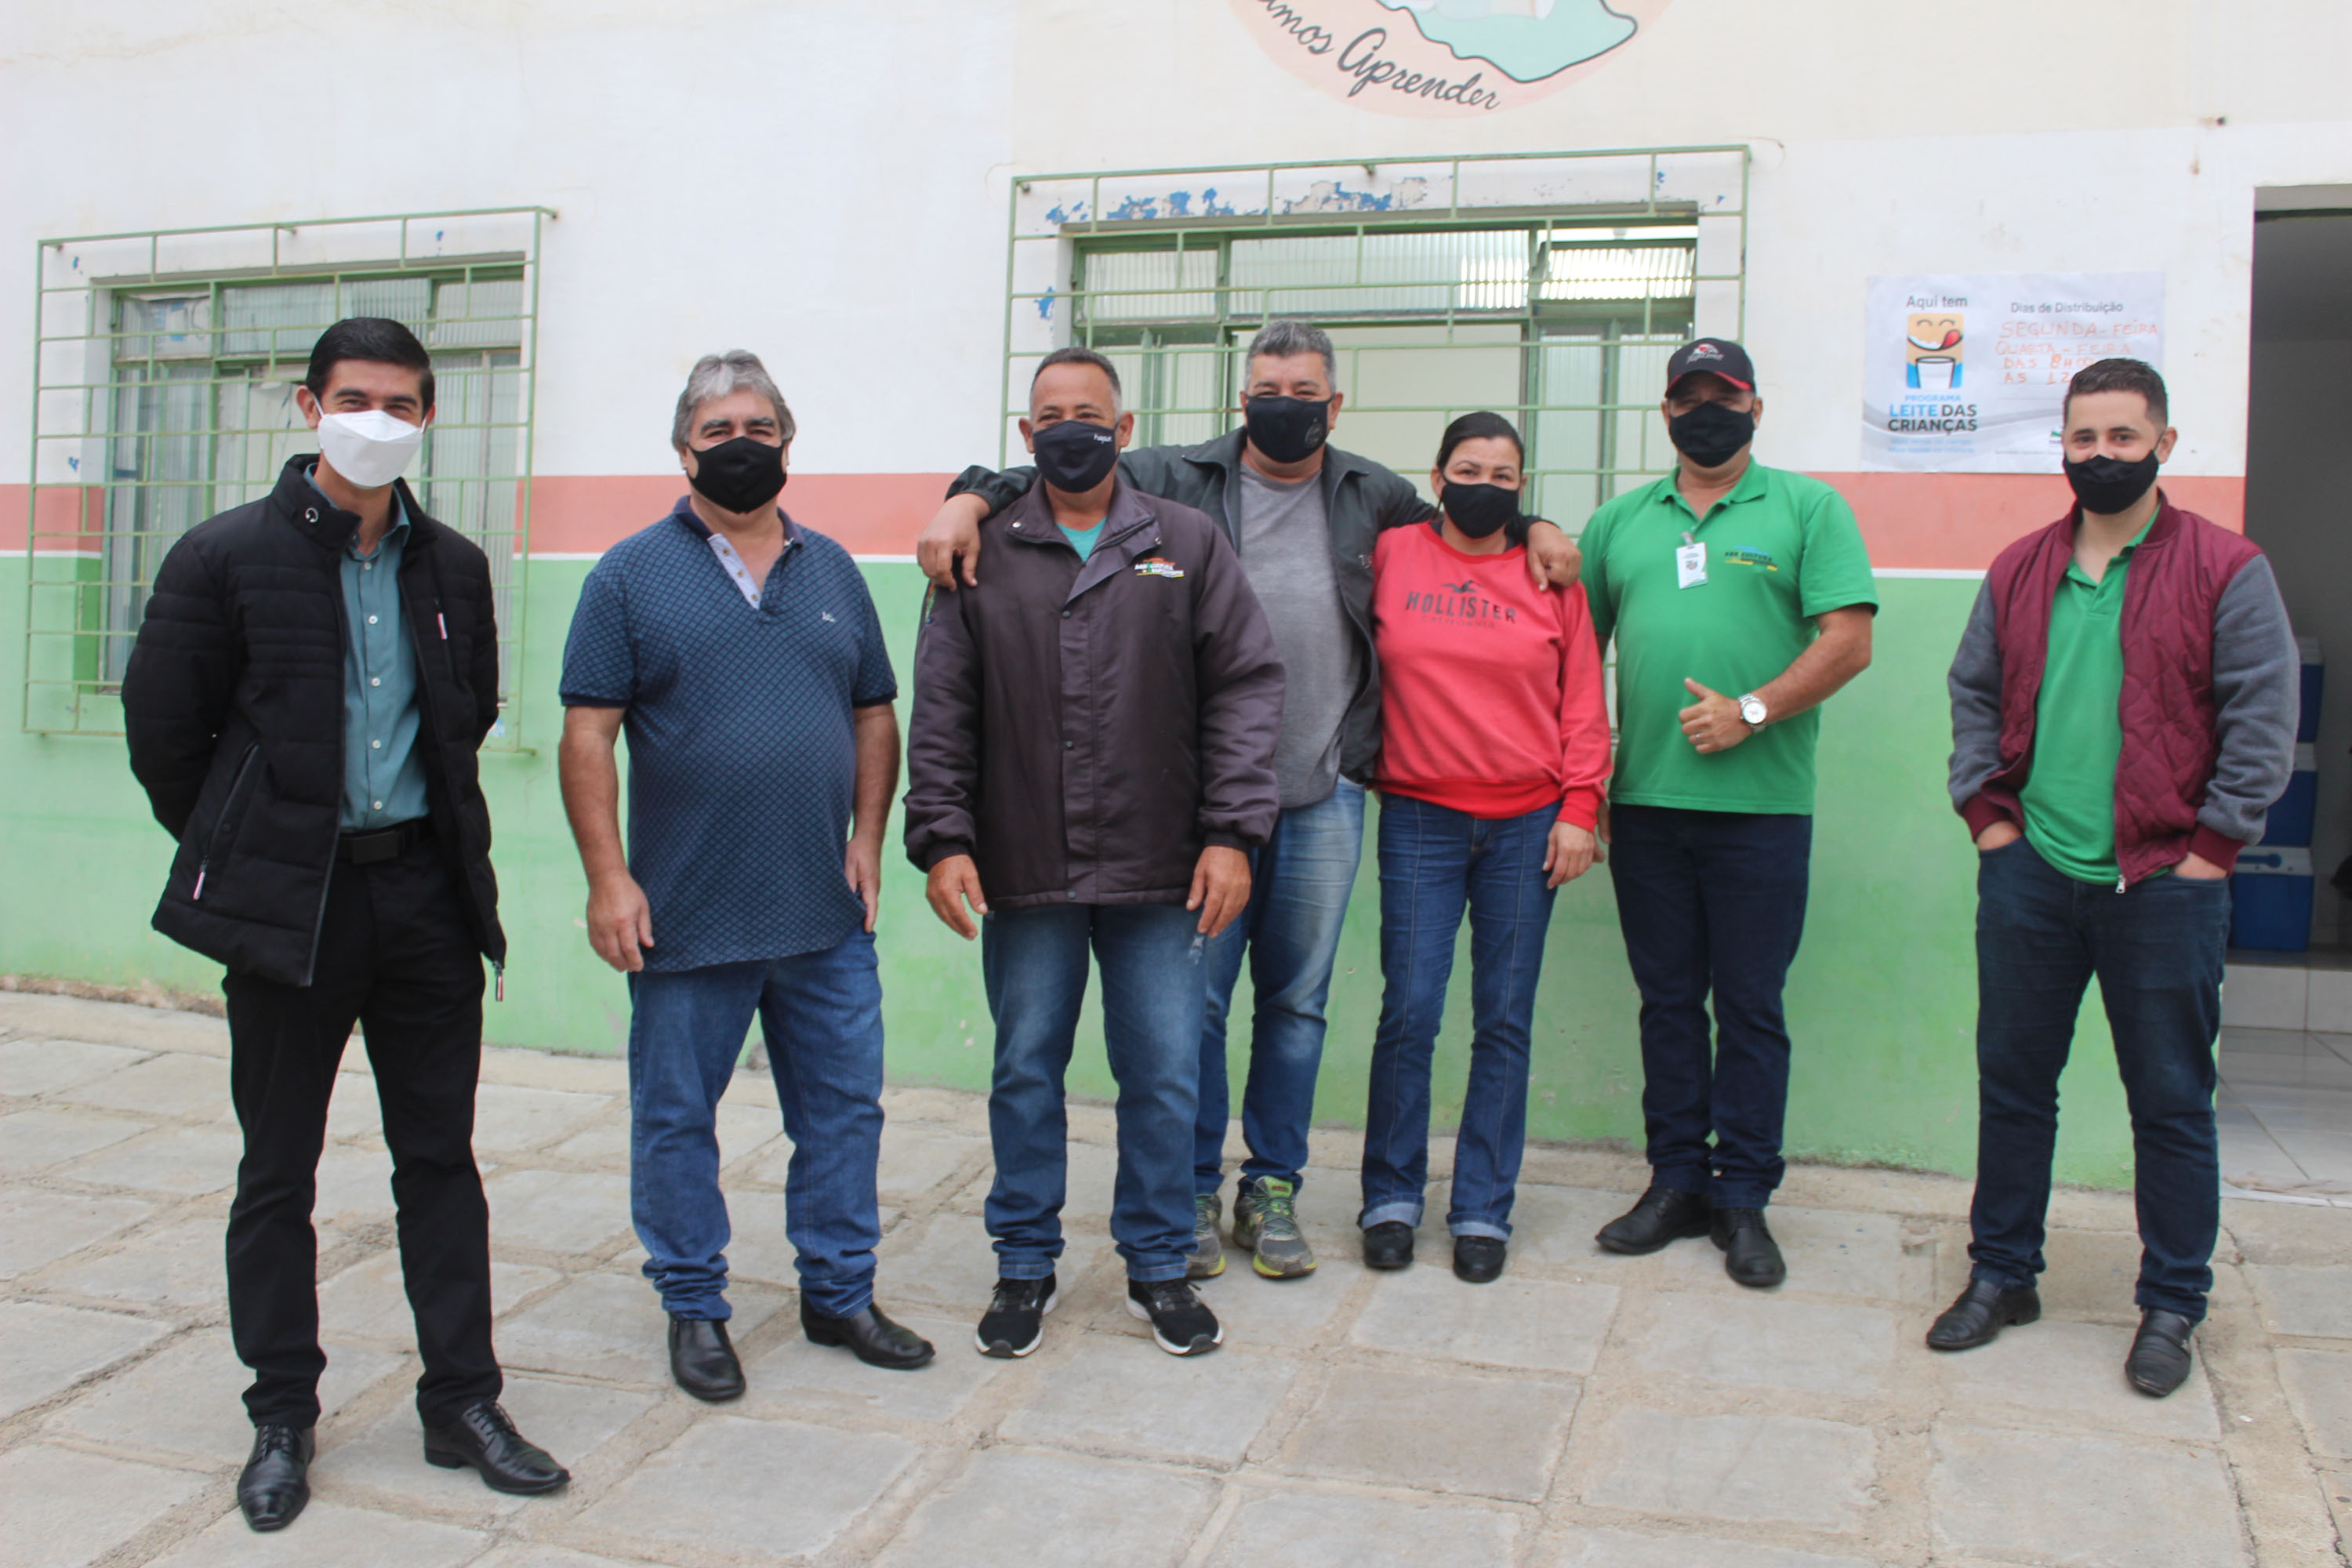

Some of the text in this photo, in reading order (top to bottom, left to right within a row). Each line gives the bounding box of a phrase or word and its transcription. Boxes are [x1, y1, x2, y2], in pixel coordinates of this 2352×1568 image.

[1258, 0, 1501, 110] mos Aprender
[1906, 295, 1969, 310] Aqui tem
[2011, 302, 2124, 314] Dias de Distribuição
[1889, 403, 1977, 417] LEITE DAS
[1887, 419, 1978, 436] CRIANÇAS
[1406, 590, 1516, 624] HOLLISTER
